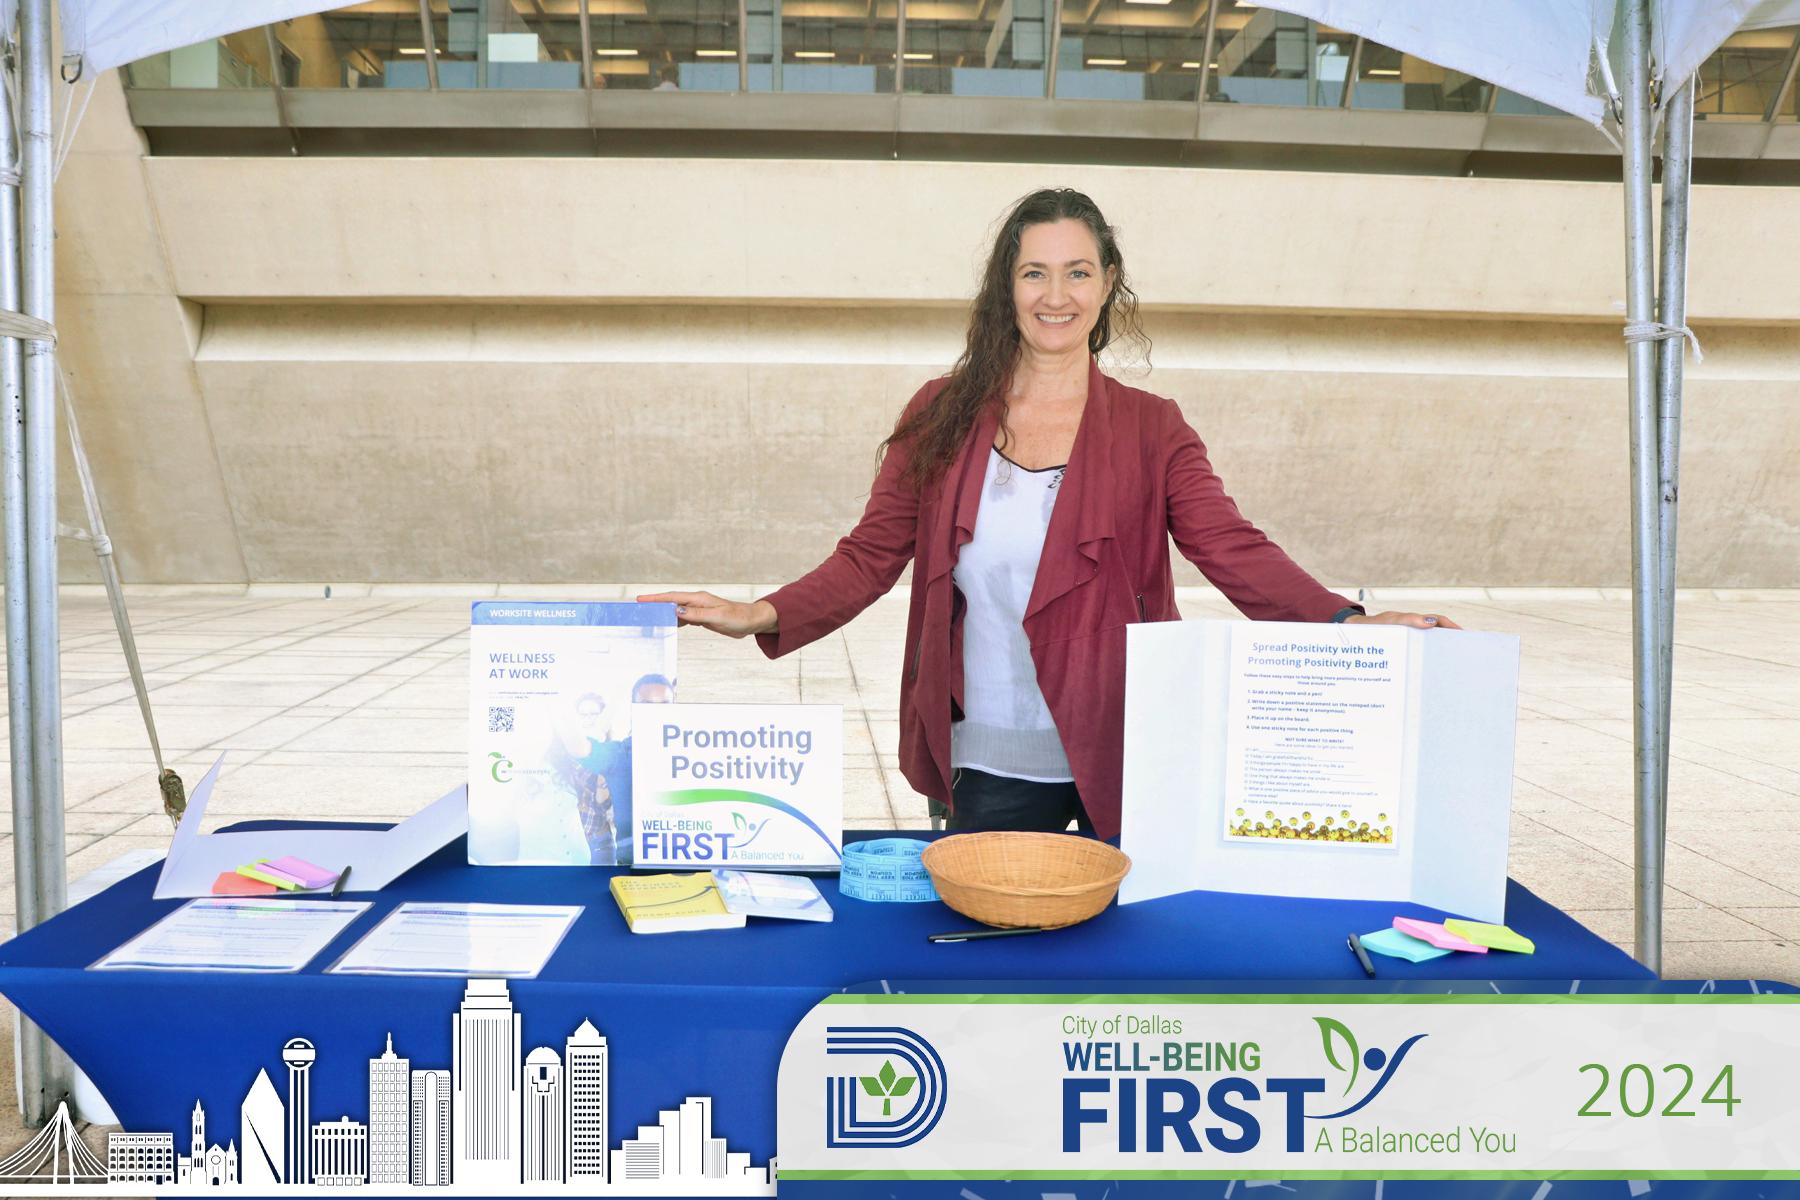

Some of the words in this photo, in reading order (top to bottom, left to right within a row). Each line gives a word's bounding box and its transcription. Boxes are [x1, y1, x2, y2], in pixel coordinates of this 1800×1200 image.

[490, 609, 532, 618] WORKSITE
[533, 610, 577, 618] WELLNESS
[1252, 642, 1288, 653] Spread
[1290, 643, 1338, 655] Positivity
[1341, 645, 1364, 655] with
[1367, 645, 1385, 655] the
[489, 653, 556, 664] WELLNESS
[1248, 656, 1301, 668] Promoting
[1304, 658, 1351, 669] Positivity
[1354, 659, 1388, 669] Board!
[489, 668, 506, 679] AT
[508, 668, 549, 679] WORK
[662, 724, 812, 755] Promoting
[671, 755, 805, 786] Positivity
[642, 819, 713, 831] WELL-BEING
[642, 833, 735, 860] FIRST
[731, 850, 738, 860] A
[741, 850, 785, 860] Balanced
[788, 851, 804, 861] You
